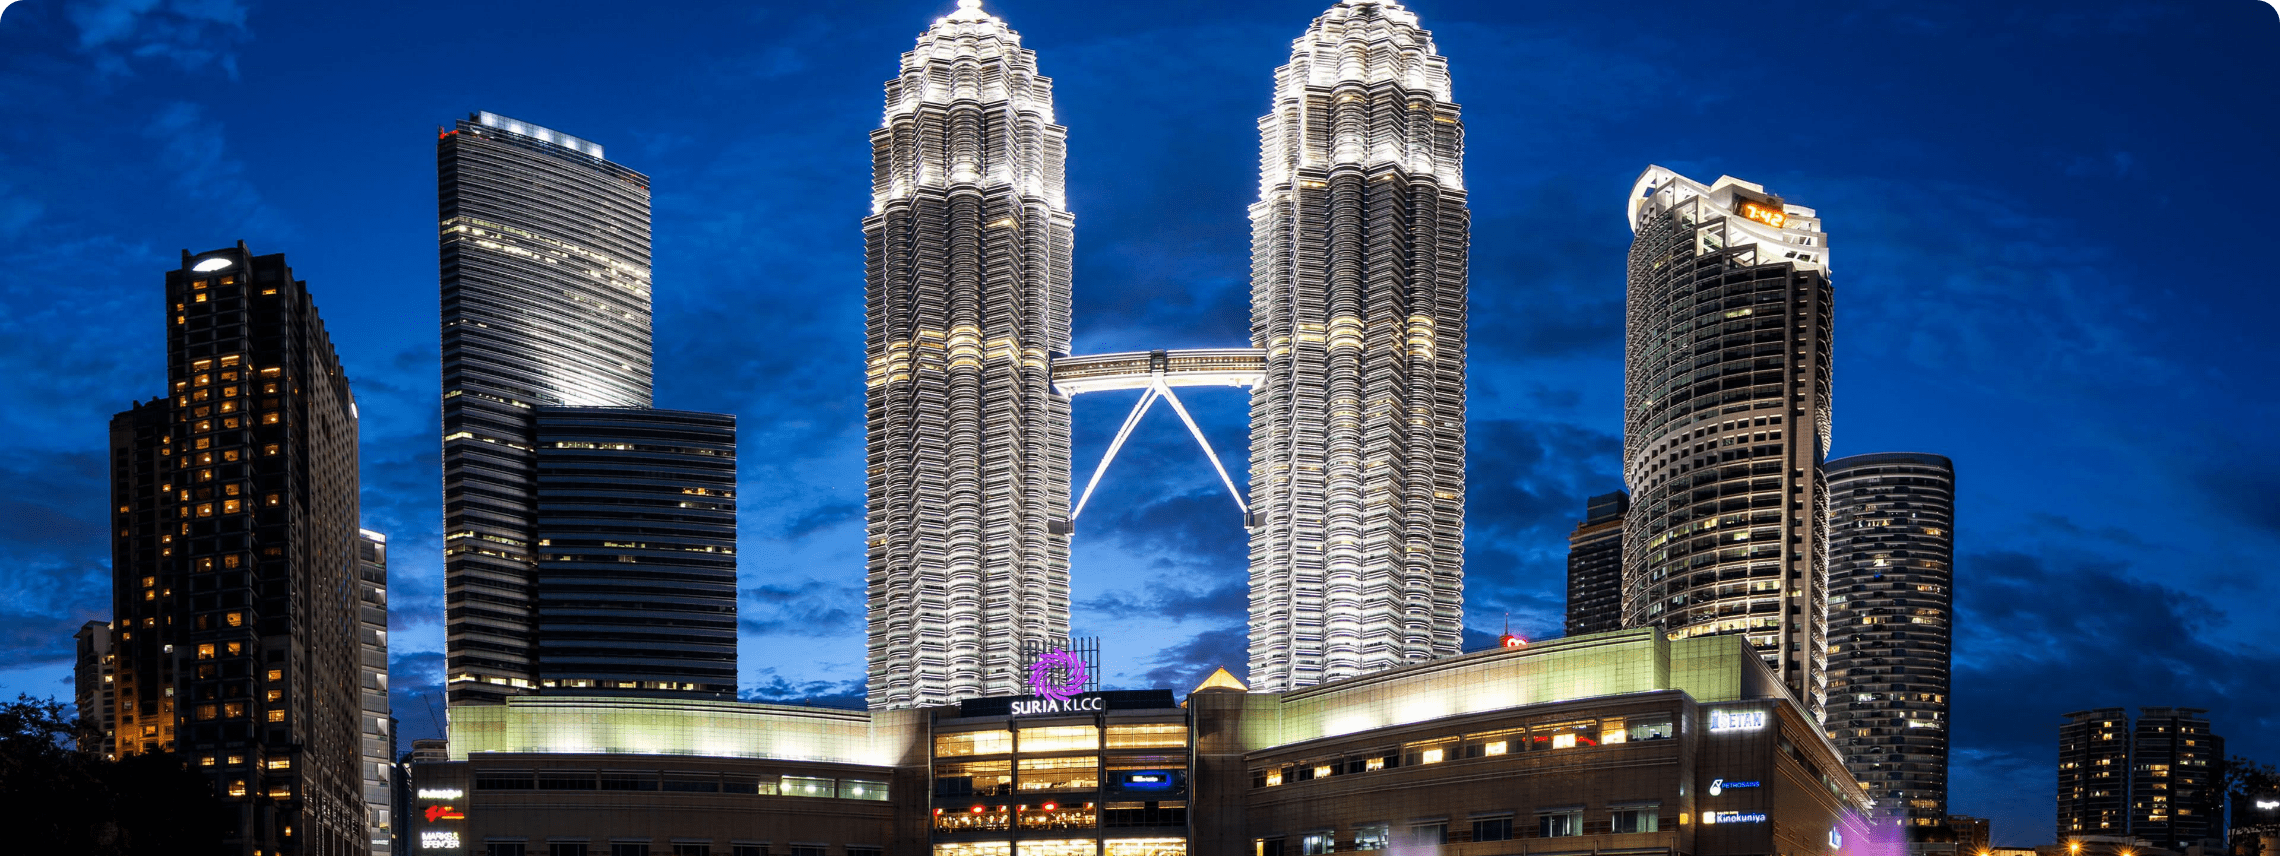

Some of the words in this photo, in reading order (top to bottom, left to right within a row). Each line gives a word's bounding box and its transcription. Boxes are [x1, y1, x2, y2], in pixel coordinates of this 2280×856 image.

[1746, 204, 1783, 227] 7:42
[1011, 699, 1059, 715] SURIA
[1063, 697, 1102, 712] KLCC
[1716, 813, 1766, 823] Kinokuniya
[421, 832, 452, 840] MARKS
[422, 840, 460, 849] SPENCER
